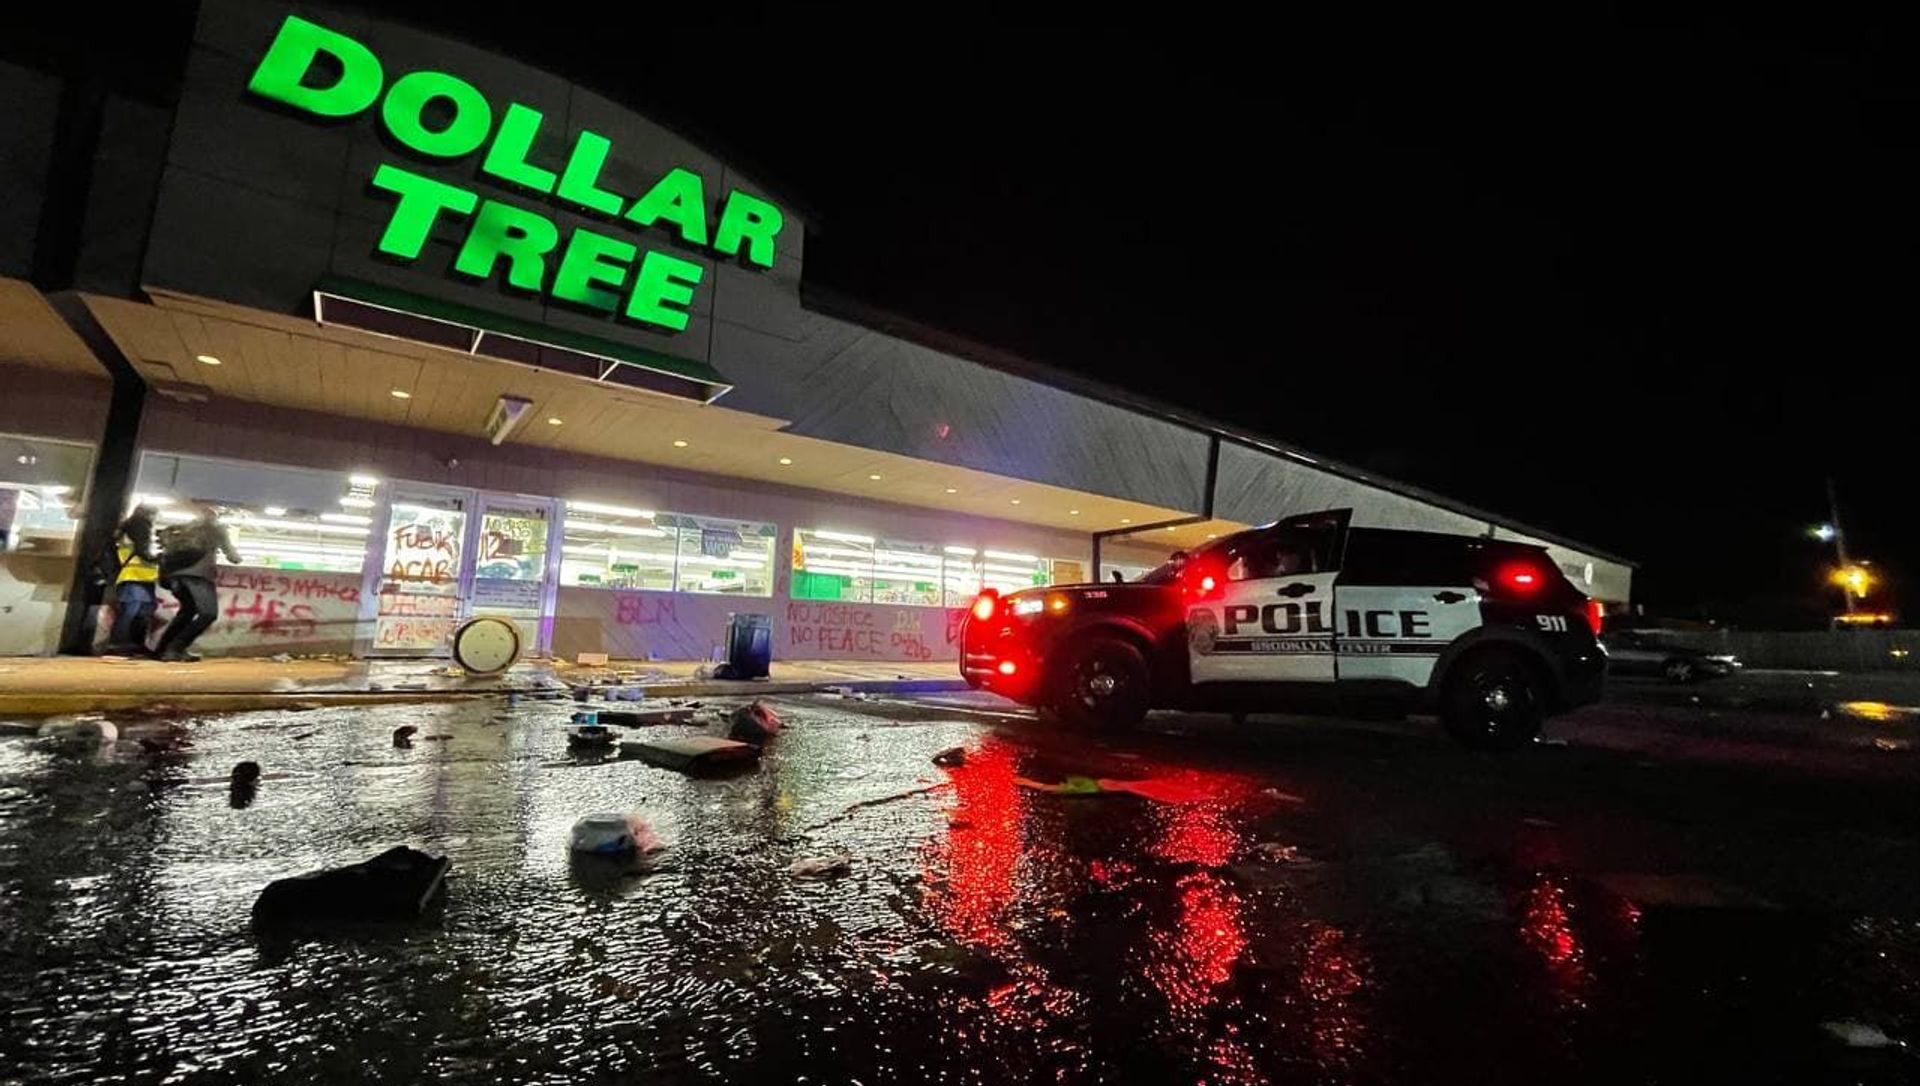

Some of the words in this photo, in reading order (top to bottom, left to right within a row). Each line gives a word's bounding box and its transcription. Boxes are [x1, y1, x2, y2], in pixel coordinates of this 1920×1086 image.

[248, 15, 783, 268] DOLLAR
[373, 164, 703, 331] TREE
[391, 557, 452, 585] ACAB
[616, 596, 676, 624] BLM
[786, 602, 809, 622] NO
[1224, 601, 1432, 638] POLICE
[1536, 615, 1567, 632] 911
[791, 627, 813, 646] NO
[818, 627, 885, 654] PEACE
[1251, 640, 1332, 651] BROOKLYN
[1338, 643, 1392, 653] CENTER
